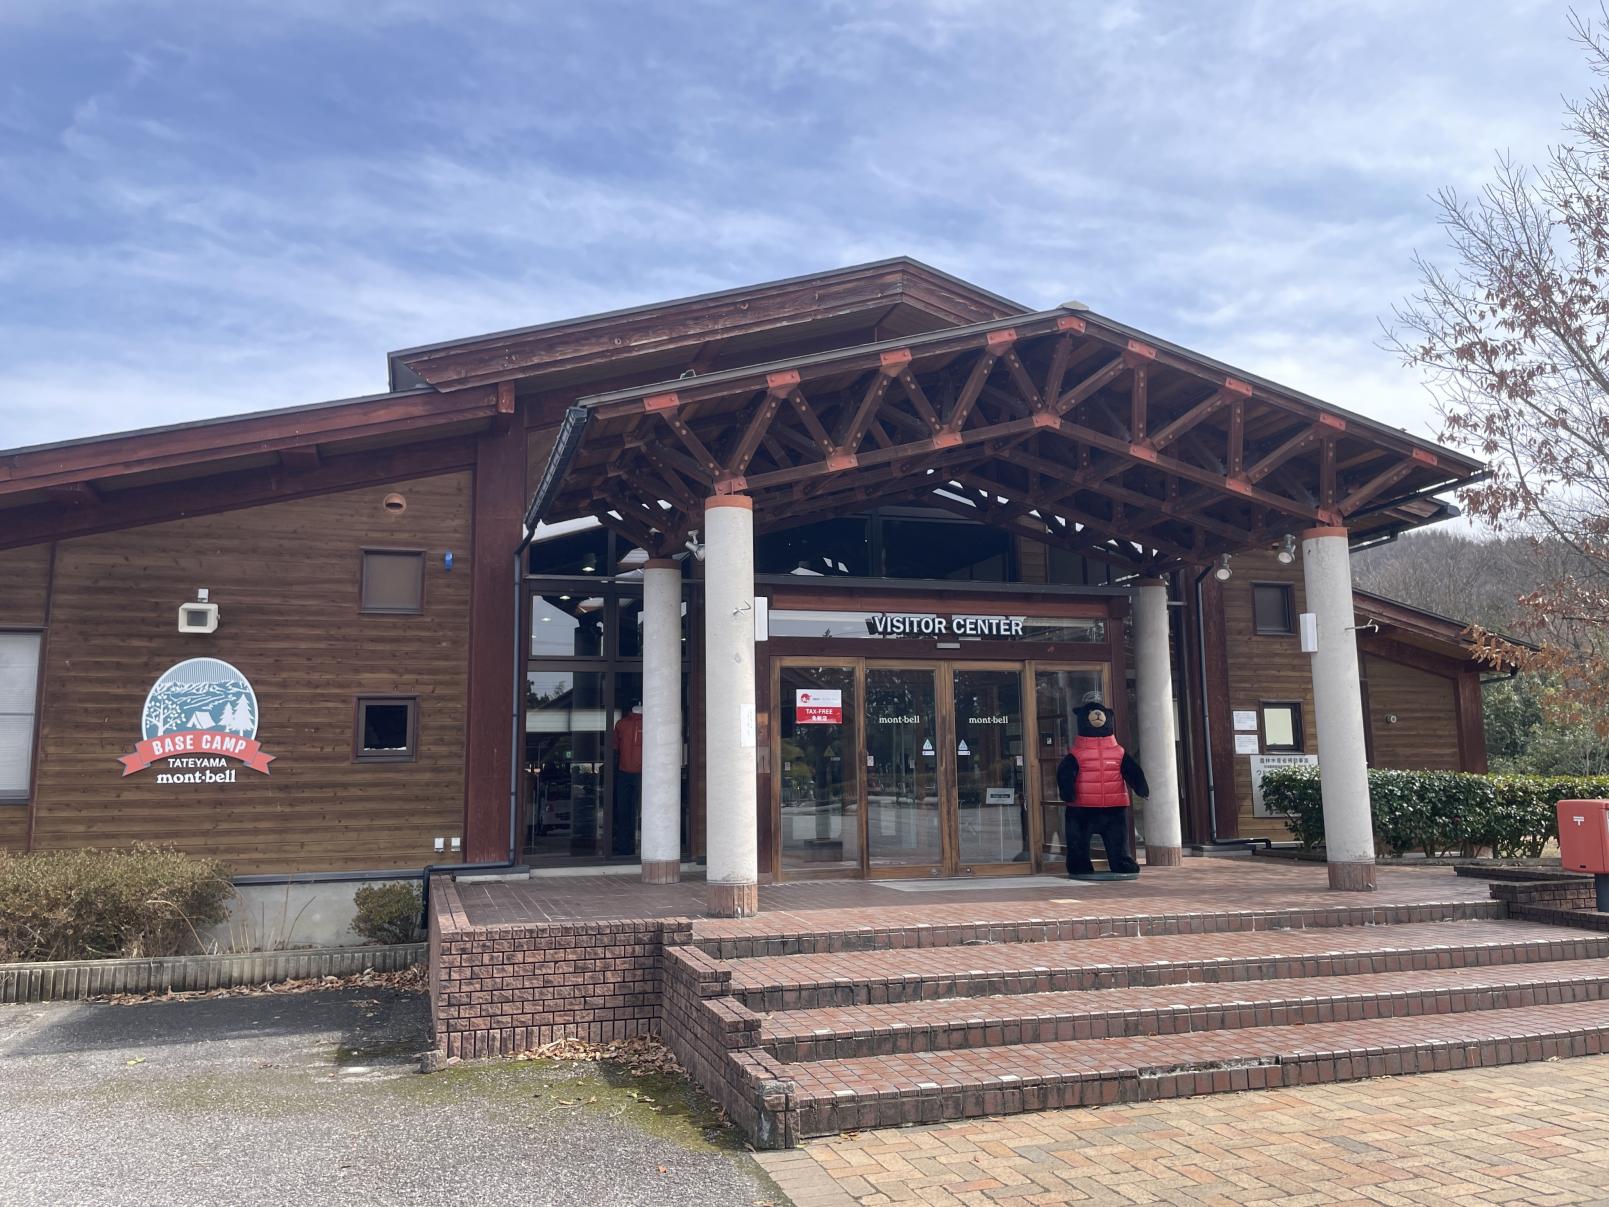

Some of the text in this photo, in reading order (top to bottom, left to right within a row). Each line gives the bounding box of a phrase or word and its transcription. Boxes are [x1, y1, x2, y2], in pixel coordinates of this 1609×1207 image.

[873, 616, 1024, 636] VISITOR CENTER
[151, 734, 247, 756] BASE CAMP
[168, 757, 228, 768] TATEYAMA
